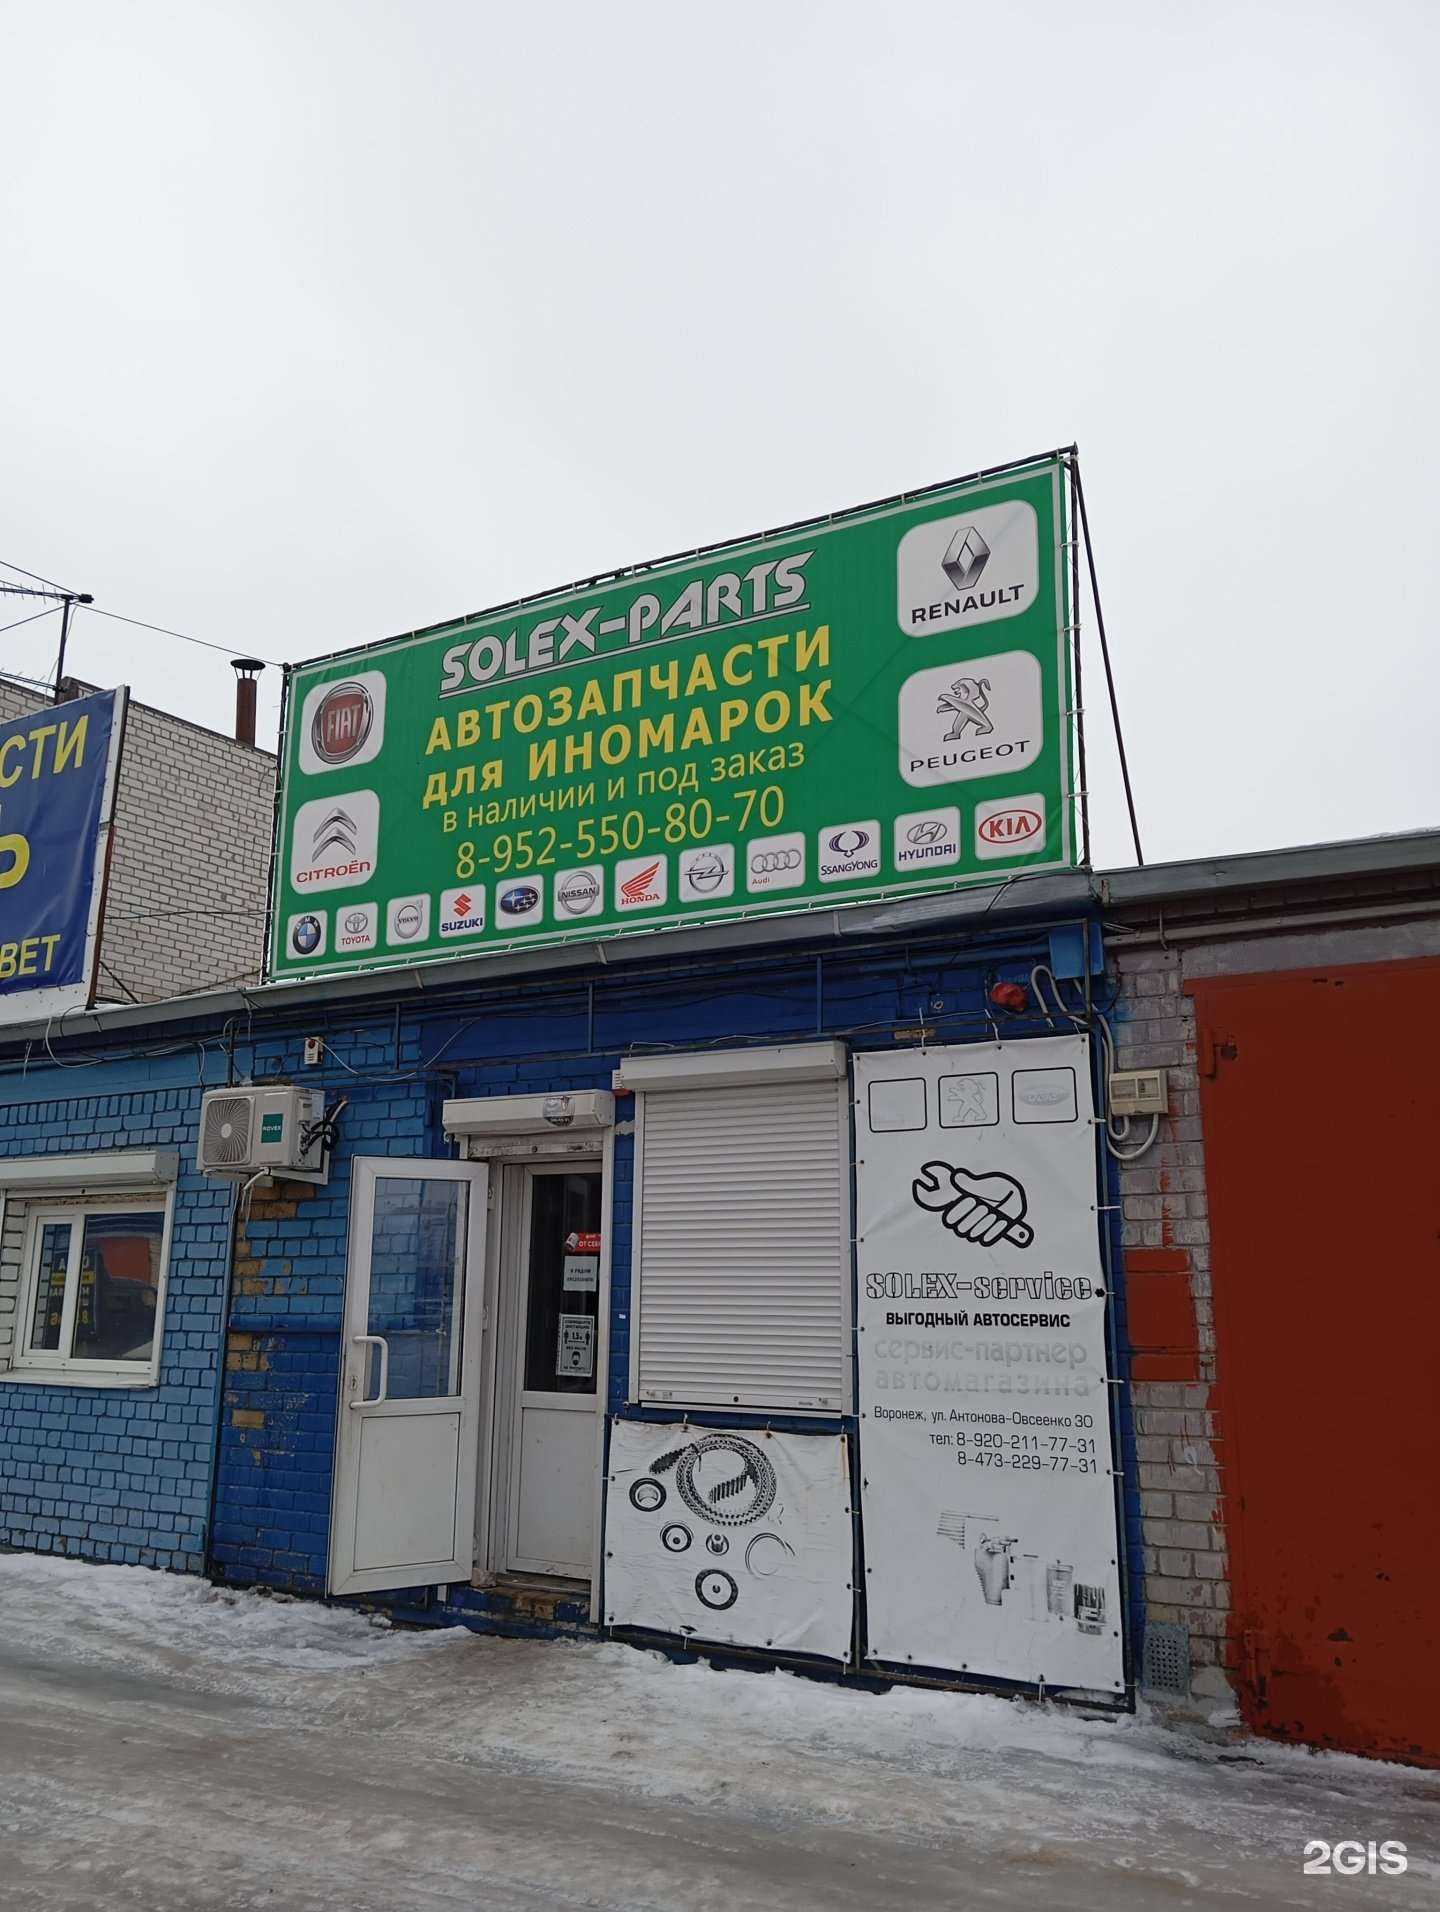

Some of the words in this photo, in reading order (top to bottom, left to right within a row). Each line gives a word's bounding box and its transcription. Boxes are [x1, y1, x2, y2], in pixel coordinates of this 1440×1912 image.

[911, 584, 1025, 624] RENAULT
[440, 549, 817, 692] SOLEX-PARTS
[425, 624, 830, 756] АВТОЗАПЧАСТИ
[326, 703, 362, 743] FIAT
[528, 679, 833, 781] ИНОМАРОК
[910, 740, 1031, 772] PEUGEOT
[443, 811, 457, 832] в
[468, 782, 595, 828] наличии
[608, 777, 625, 801] и
[638, 763, 699, 795] под
[710, 742, 805, 782] заказ
[456, 785, 785, 879] 8-952-550-80-70
[989, 815, 1032, 838] KIA
[898, 843, 956, 862] HYUNDAI
[751, 877, 770, 886] Audi
[560, 887, 597, 900] NISSAN
[621, 893, 660, 905] HONDA
[441, 917, 484, 932] SUZUKI
[341, 936, 371, 946] TOYOTA
[866, 1271, 1092, 1300] SOLEX-service
[886, 1308, 969, 1328] ВЫГОДНЫЙ
[973, 1313, 1071, 1328] АВТОСЕРВИС
[874, 1339, 1088, 1370] сервис-партнер
[874, 1405, 927, 1422] Воронеж,
[931, 1410, 947, 1423] ул.
[950, 1408, 1072, 1428] Антонова-Овсеенко
[1074, 1414, 1094, 1428] 30
[929, 1432, 953, 1446] тел:
[956, 1432, 1096, 1454] 8-920-211-77-31
[957, 1451, 1097, 1474] 8-473-229-77-31
